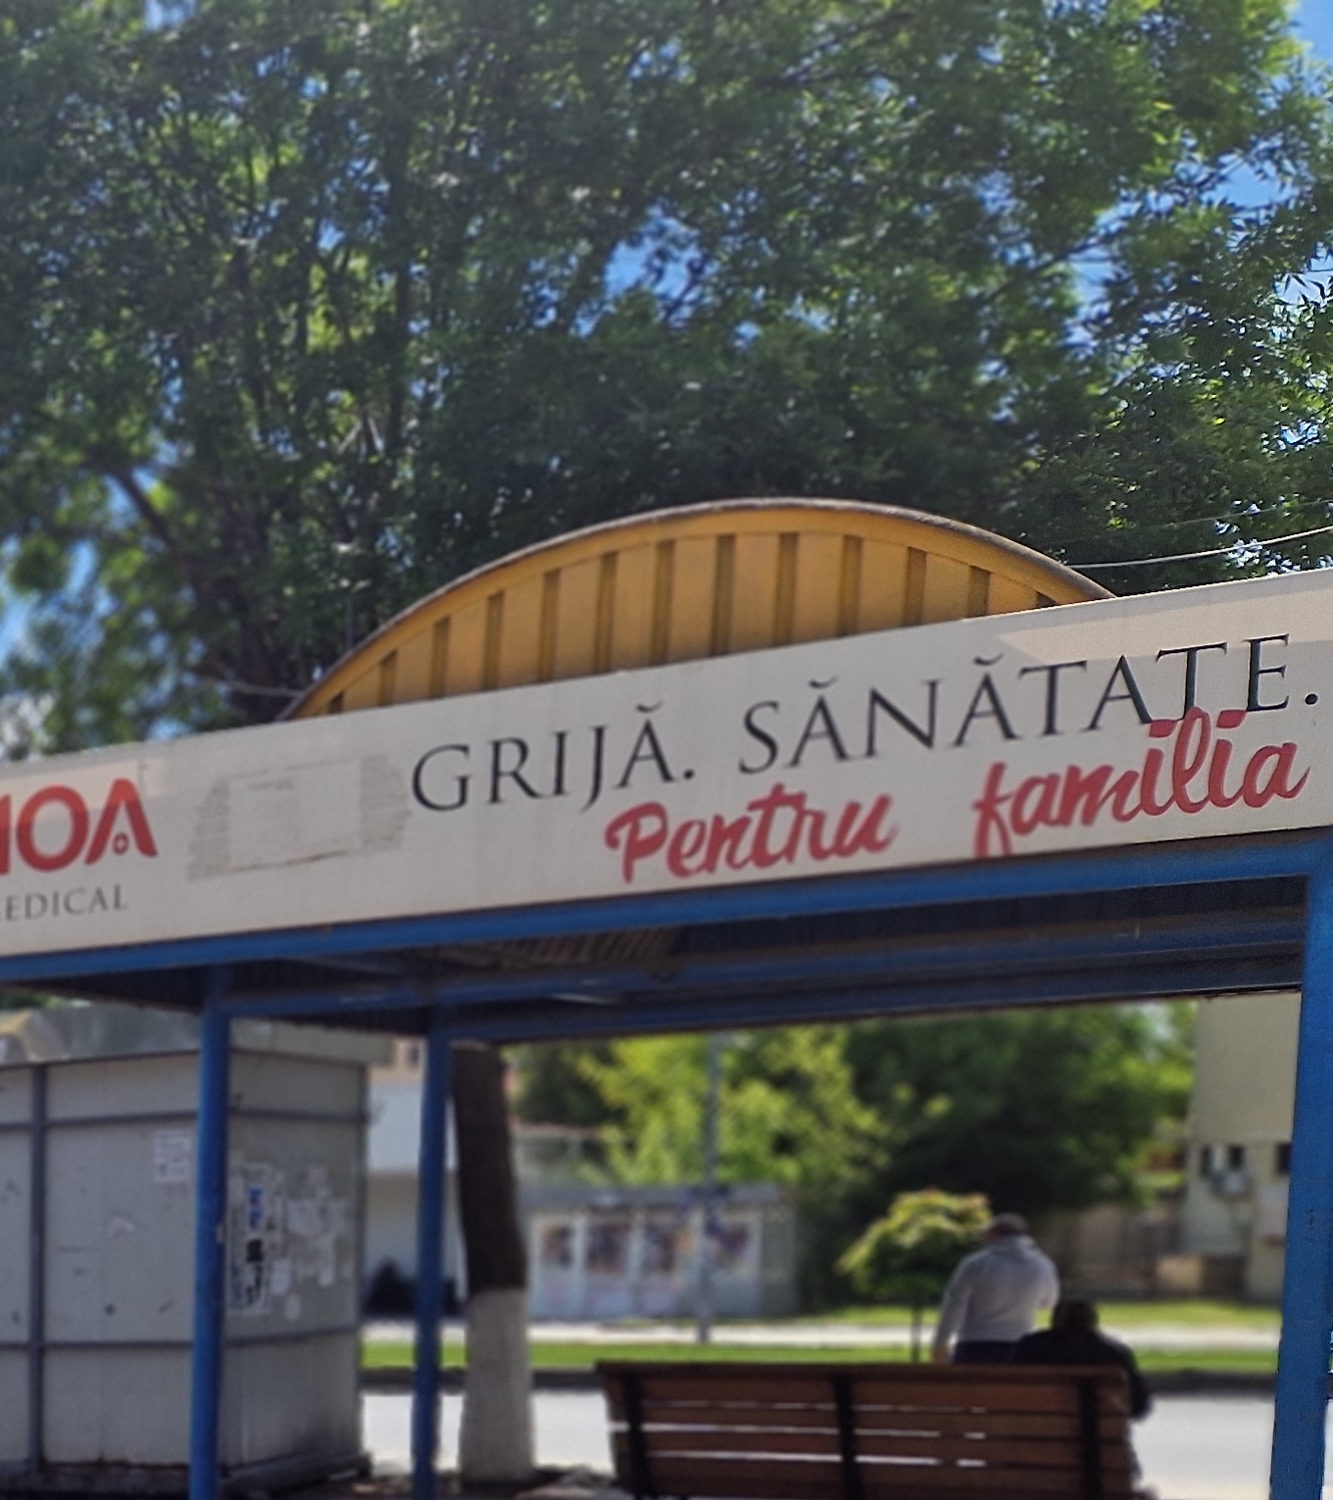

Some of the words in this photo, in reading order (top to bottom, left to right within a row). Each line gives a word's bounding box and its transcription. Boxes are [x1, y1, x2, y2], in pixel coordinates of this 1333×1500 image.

[411, 700, 695, 814] GRIJĂ.
[738, 632, 1319, 776] SĂNĂTATE.
[603, 782, 899, 884] Pentru
[972, 705, 1311, 860] familia
